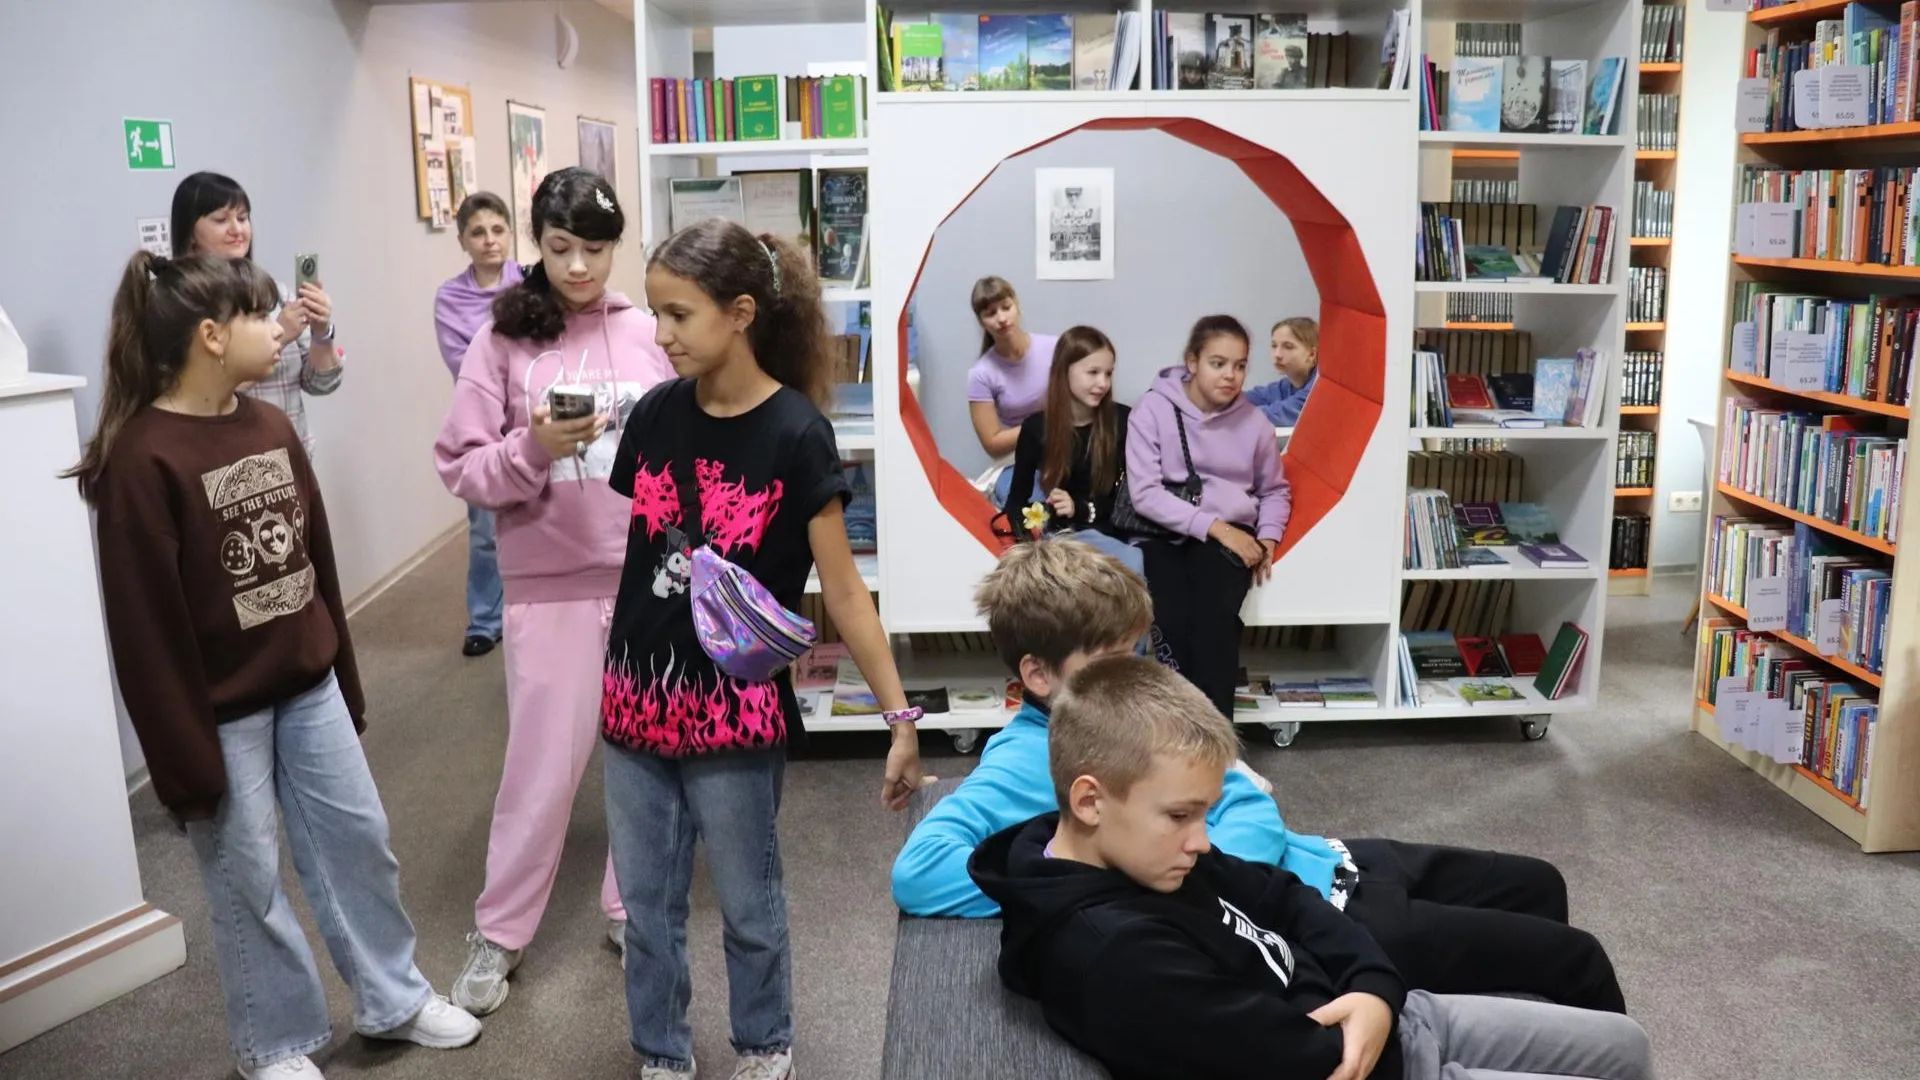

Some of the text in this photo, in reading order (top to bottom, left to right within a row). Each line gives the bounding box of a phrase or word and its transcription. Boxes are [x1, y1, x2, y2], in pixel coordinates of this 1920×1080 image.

[1870, 317, 1880, 363] МАРКЕТИНГ
[582, 369, 603, 381] ARE
[222, 505, 241, 522] SEE
[241, 495, 264, 514] THE
[1824, 751, 1832, 770] 200
